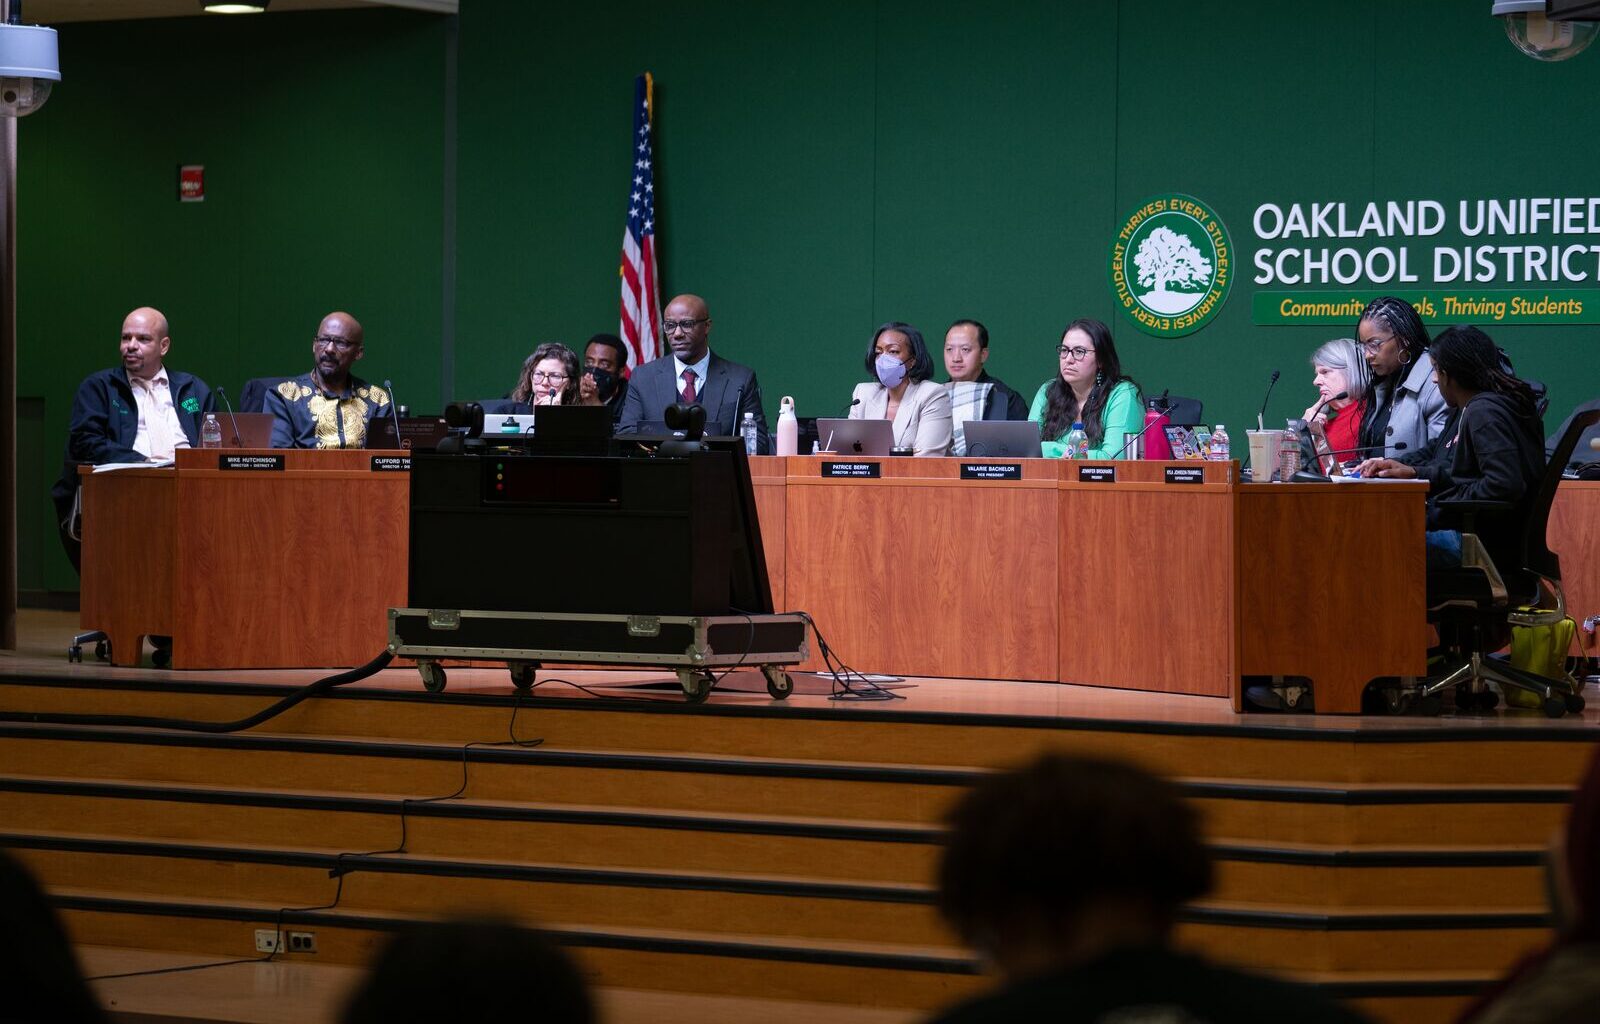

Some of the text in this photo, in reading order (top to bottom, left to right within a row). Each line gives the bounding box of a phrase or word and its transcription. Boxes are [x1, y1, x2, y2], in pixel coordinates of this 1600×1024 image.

[1253, 200, 1446, 240] OAKLAND
[1112, 199, 1229, 330] EVERY STUDENT THRIVES! EVERY STUDENT THRIVES!
[1254, 246, 1419, 285] SCHOOL
[1443, 296, 1506, 320] Thriving
[1510, 295, 1583, 315] Students
